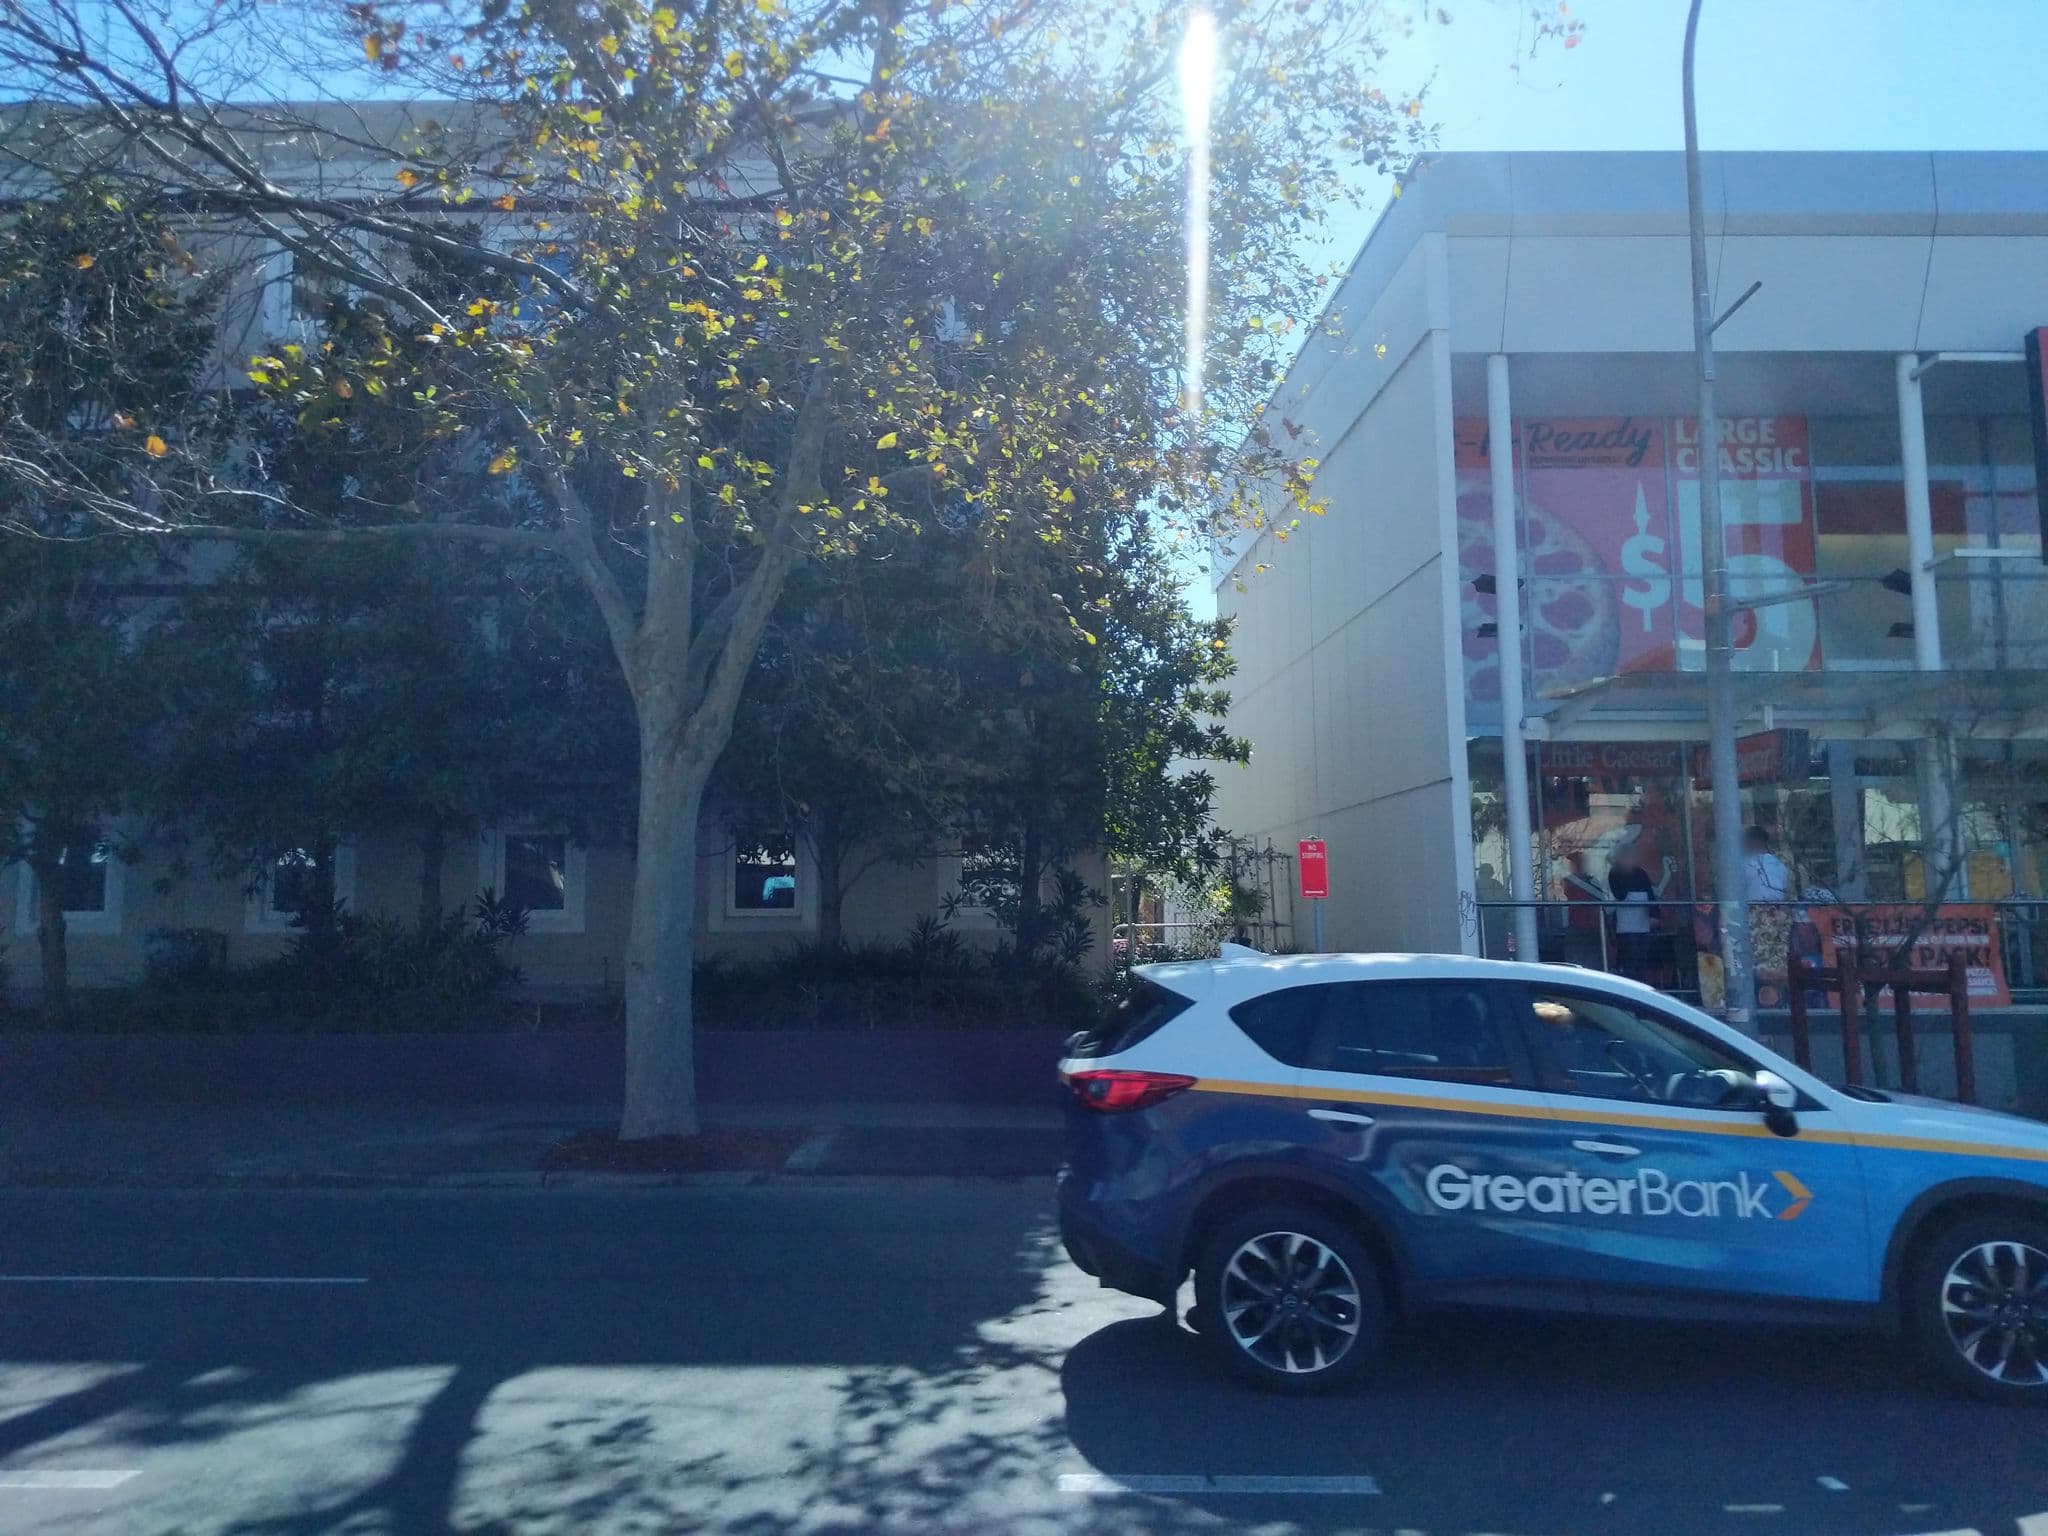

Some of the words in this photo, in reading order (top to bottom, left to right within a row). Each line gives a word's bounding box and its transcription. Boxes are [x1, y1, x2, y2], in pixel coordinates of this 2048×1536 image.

[1676, 418, 1776, 444] LRGE
[1677, 447, 1802, 473] CASSIC
[1426, 1163, 1774, 1220] GreaterBank
